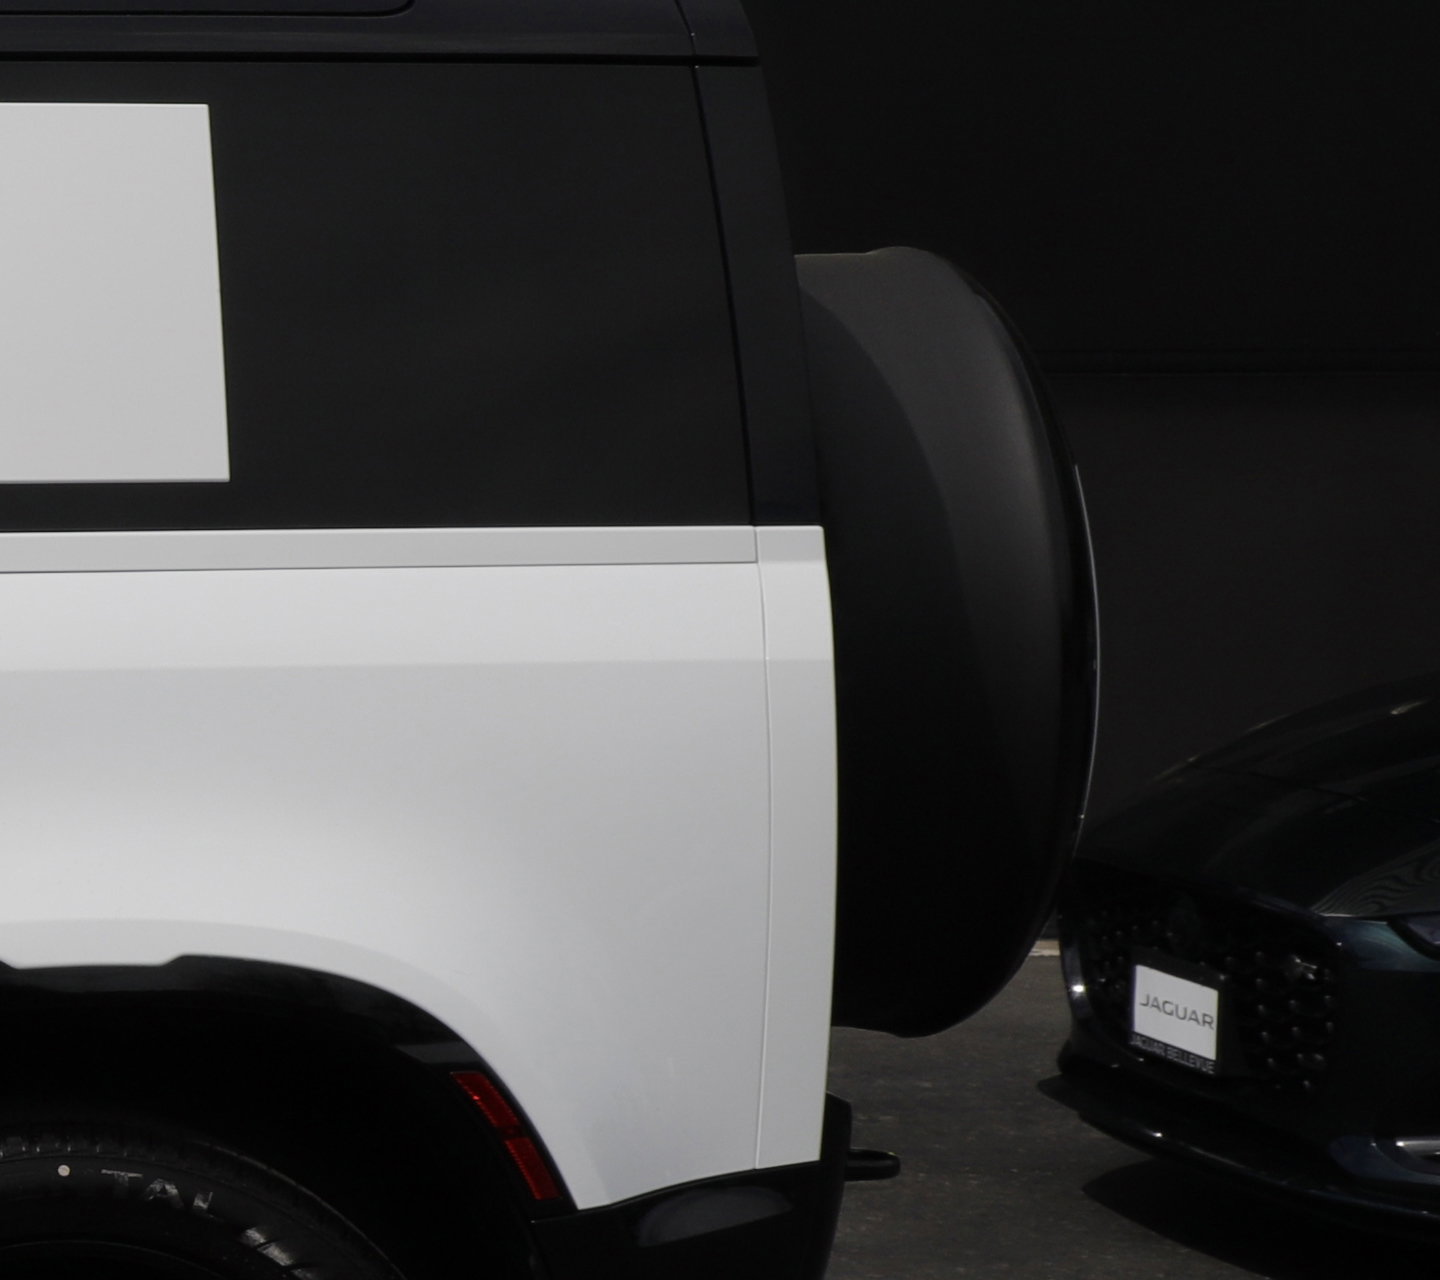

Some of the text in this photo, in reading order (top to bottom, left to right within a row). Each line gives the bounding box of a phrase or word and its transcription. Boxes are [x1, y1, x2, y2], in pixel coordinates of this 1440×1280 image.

[1139, 994, 1214, 1030] JAGUAR
[1129, 1033, 1216, 1076] JAGUAR BELLEVUE
